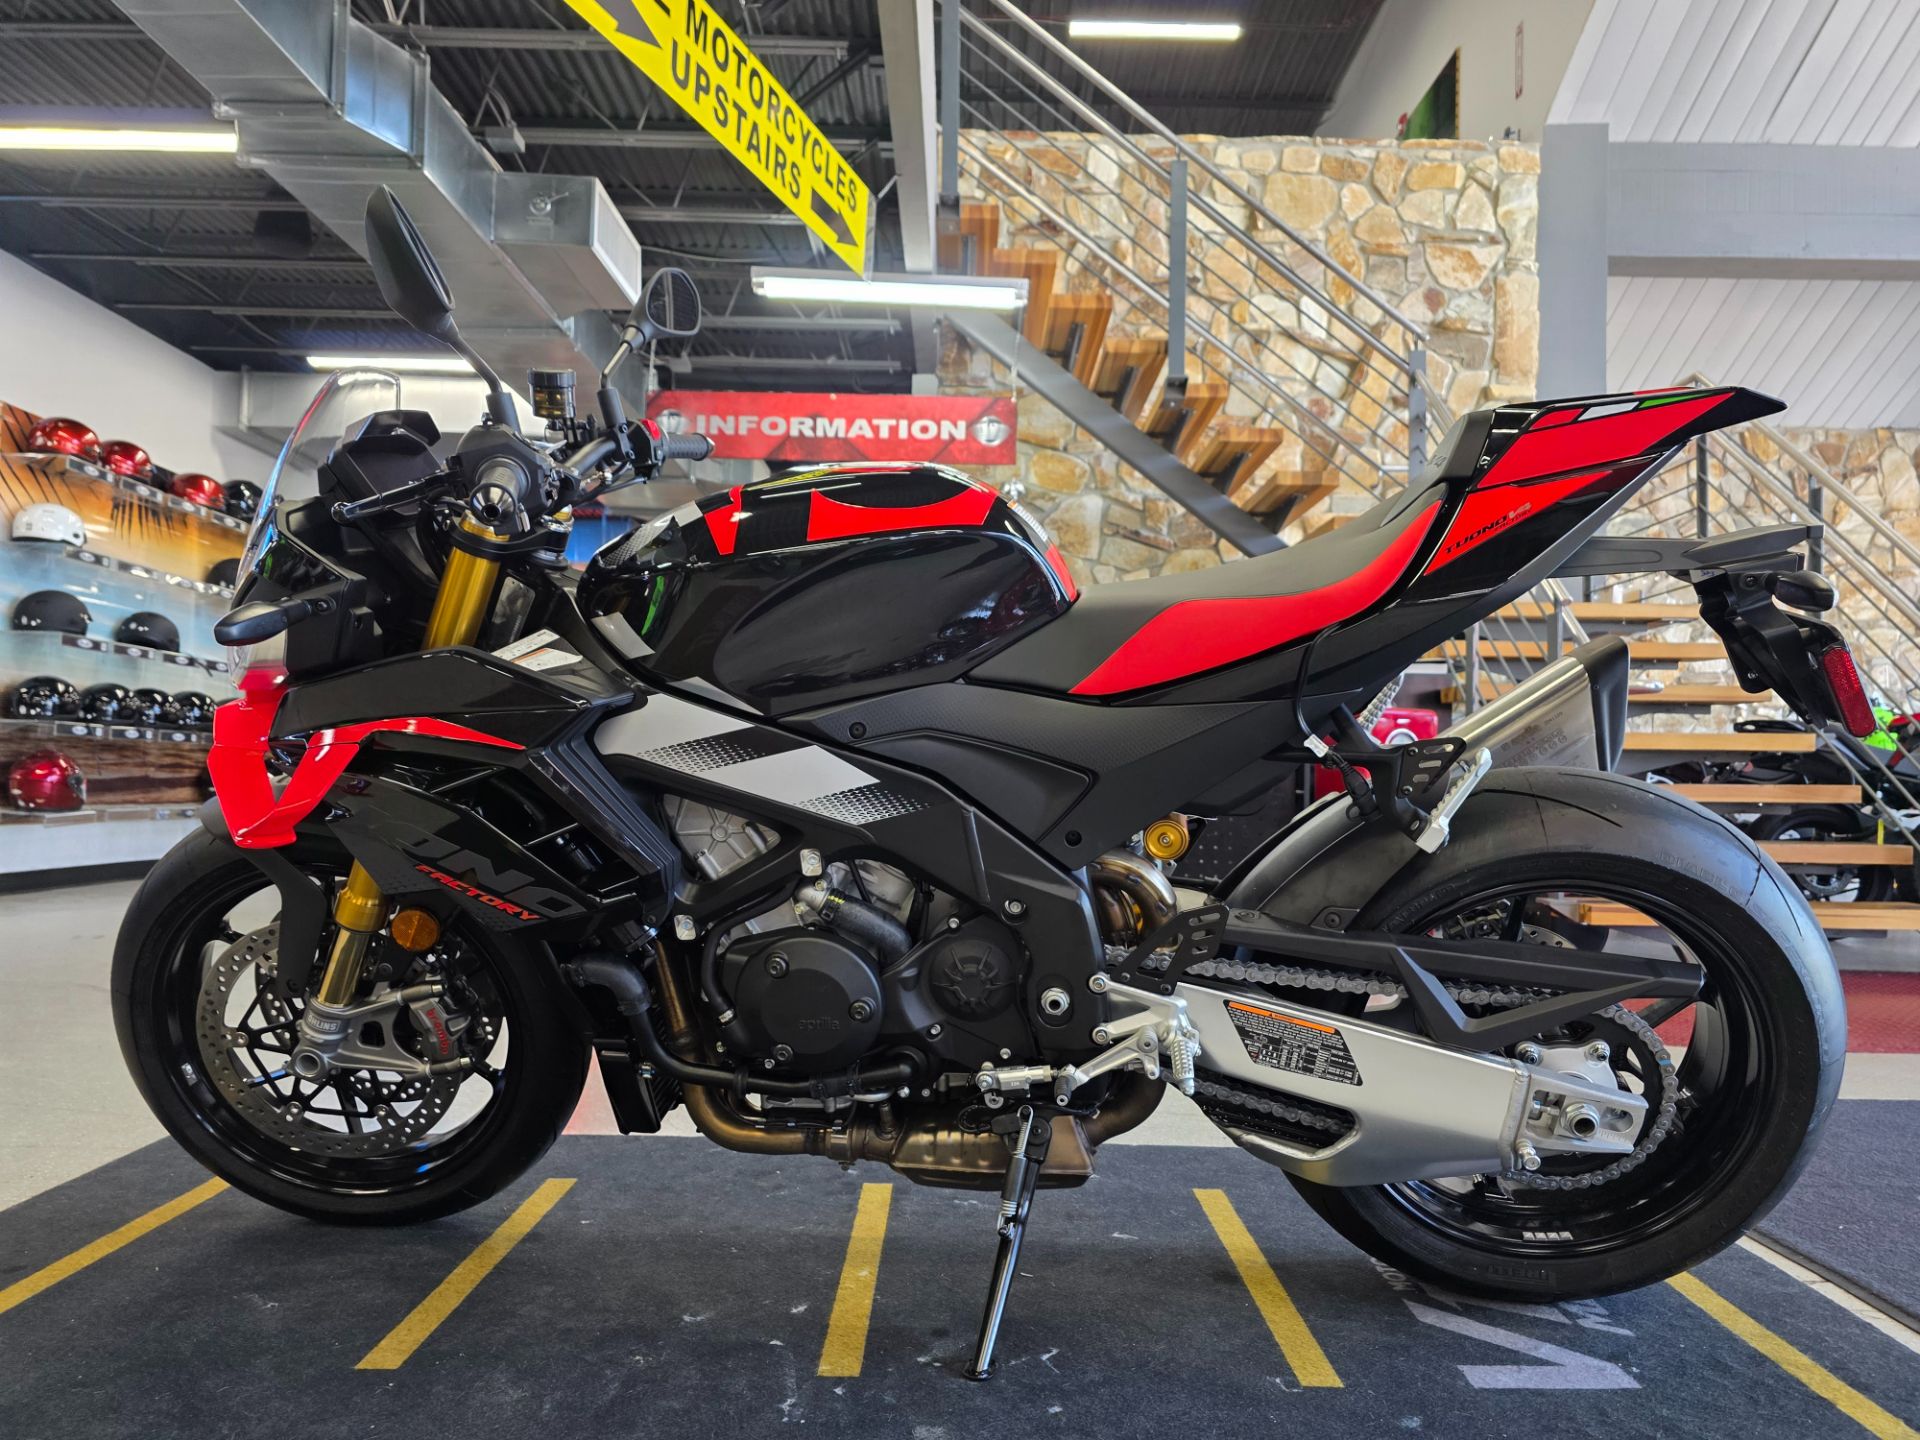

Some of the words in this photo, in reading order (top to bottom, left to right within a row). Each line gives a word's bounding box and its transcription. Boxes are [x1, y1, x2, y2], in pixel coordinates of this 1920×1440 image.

[671, 37, 802, 201] UPSTAIRS
[685, 3, 858, 213] MOTORCYCLES
[695, 414, 967, 441] INFORMATION
[414, 862, 543, 921] FACTORY
